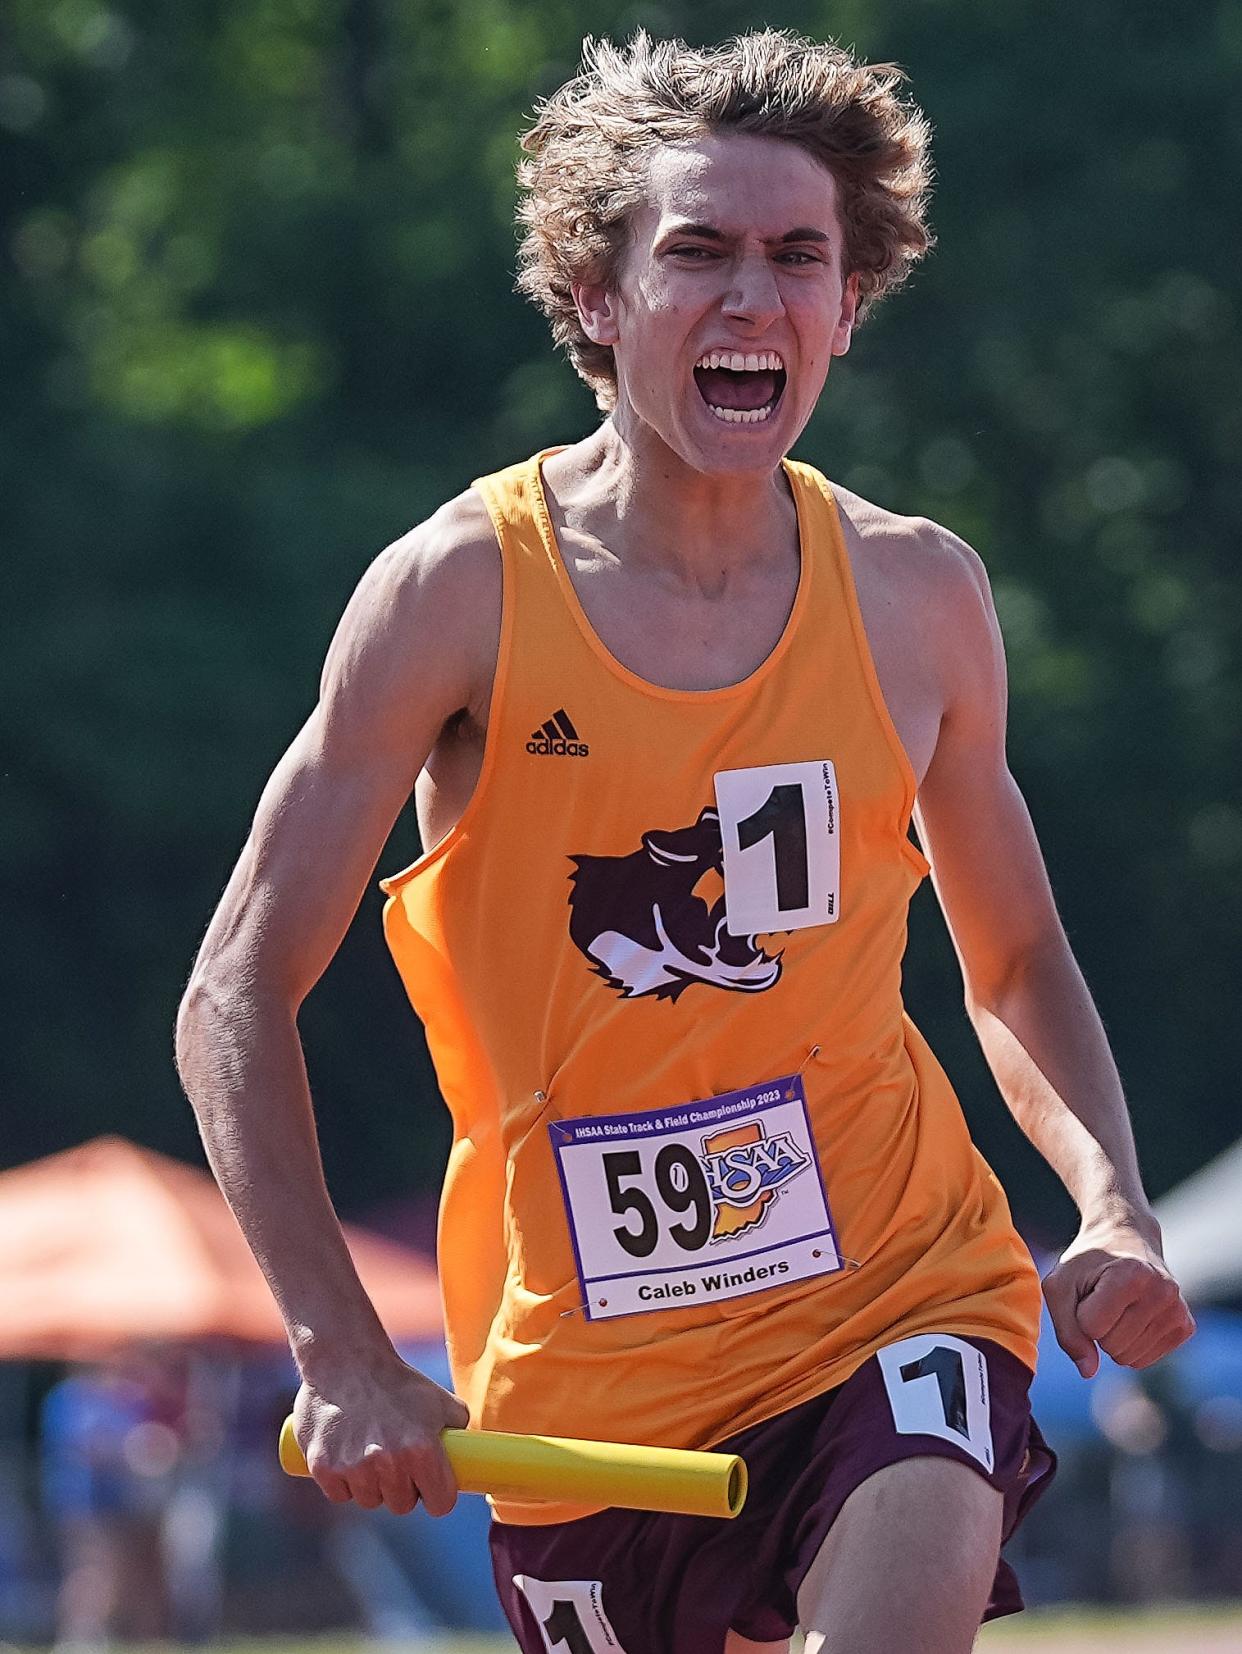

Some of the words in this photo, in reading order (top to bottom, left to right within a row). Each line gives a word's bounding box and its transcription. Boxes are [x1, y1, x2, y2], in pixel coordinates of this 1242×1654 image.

[526, 738, 589, 757] adidas
[736, 783, 809, 912] 1
[575, 1127, 604, 1138] IHSAA
[604, 1123, 629, 1135] State
[628, 1120, 654, 1133] Track
[655, 1118, 664, 1130] &
[664, 1114, 689, 1129] Field
[689, 1098, 757, 1123] Championship
[757, 1089, 781, 1106] 2023
[602, 1143, 712, 1258] 59
[638, 1280, 697, 1301] Caleb
[701, 1260, 790, 1292] Winders
[899, 1346, 971, 1441] 1
